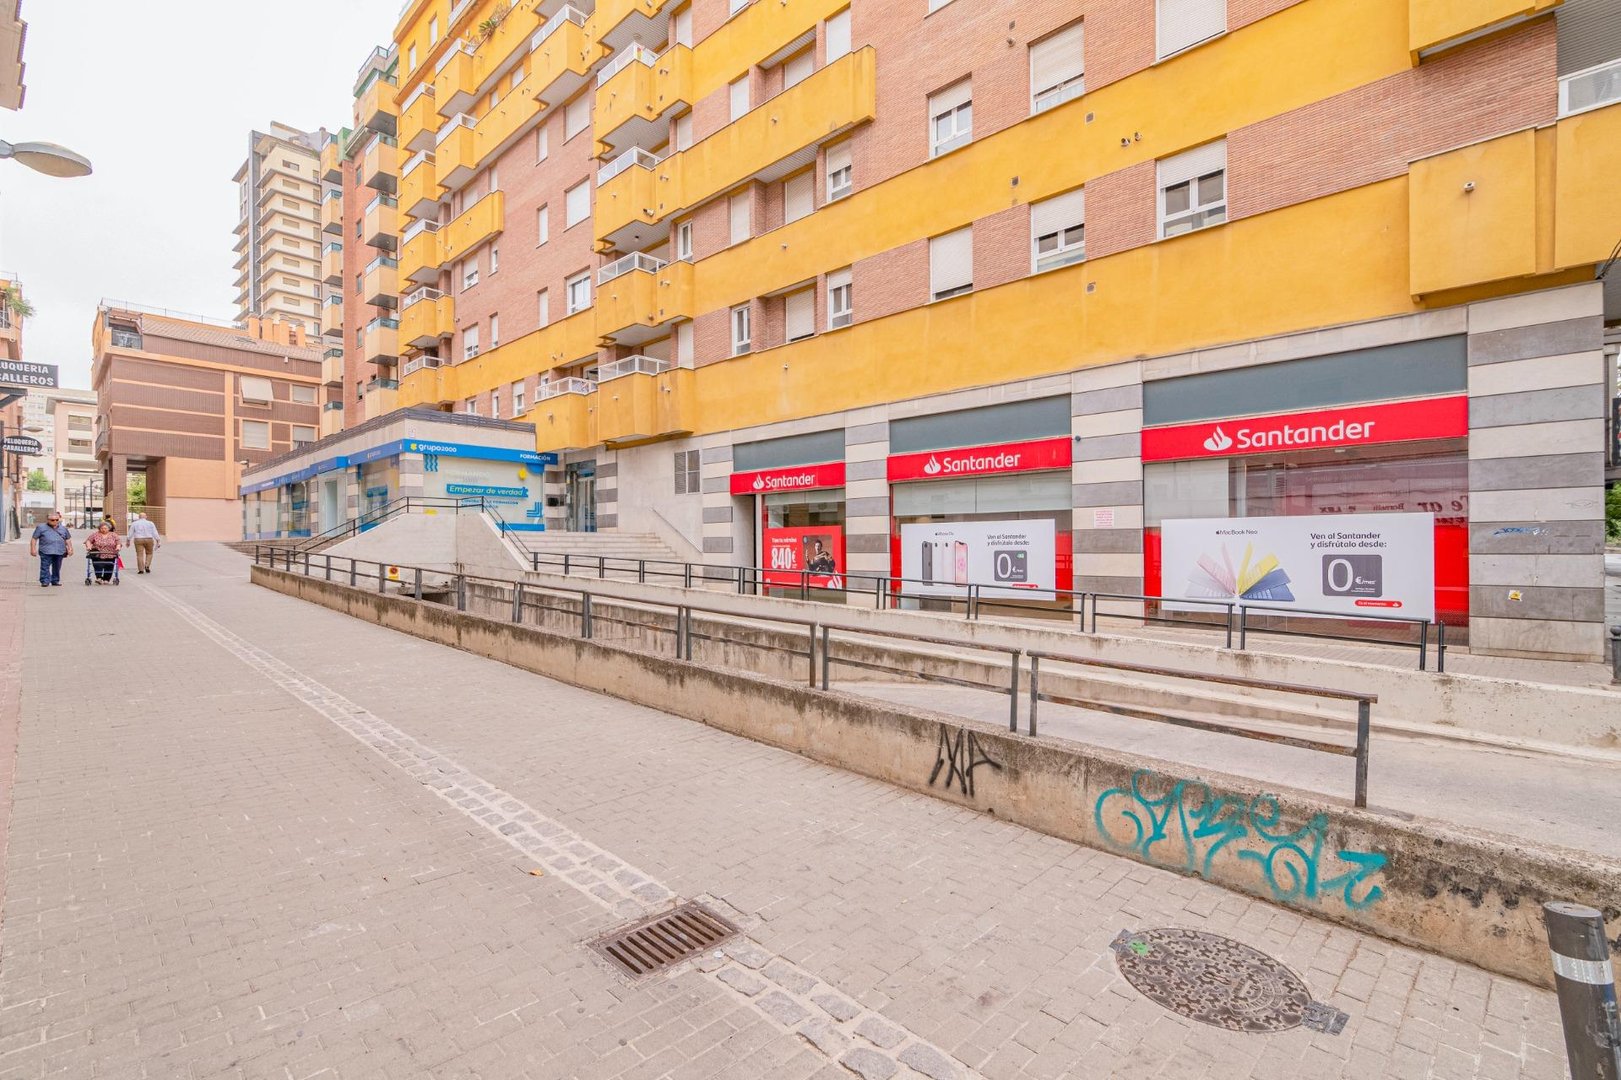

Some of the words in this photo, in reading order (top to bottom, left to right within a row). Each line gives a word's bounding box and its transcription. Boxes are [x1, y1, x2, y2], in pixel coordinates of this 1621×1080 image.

[0, 361, 49, 374] UQUERIA
[0, 372, 54, 386] ALLEROS
[1237, 419, 1376, 449] Santander
[418, 444, 457, 453] grupo2000
[943, 452, 1021, 473] Santander
[765, 473, 815, 488] Santander
[449, 485, 484, 493] Empezar
[497, 488, 523, 496] verdad
[1327, 532, 1336, 540] al
[1336, 532, 1381, 540] Santander
[1317, 540, 1357, 548] disfrútalo
[1358, 540, 1387, 548] desde:
